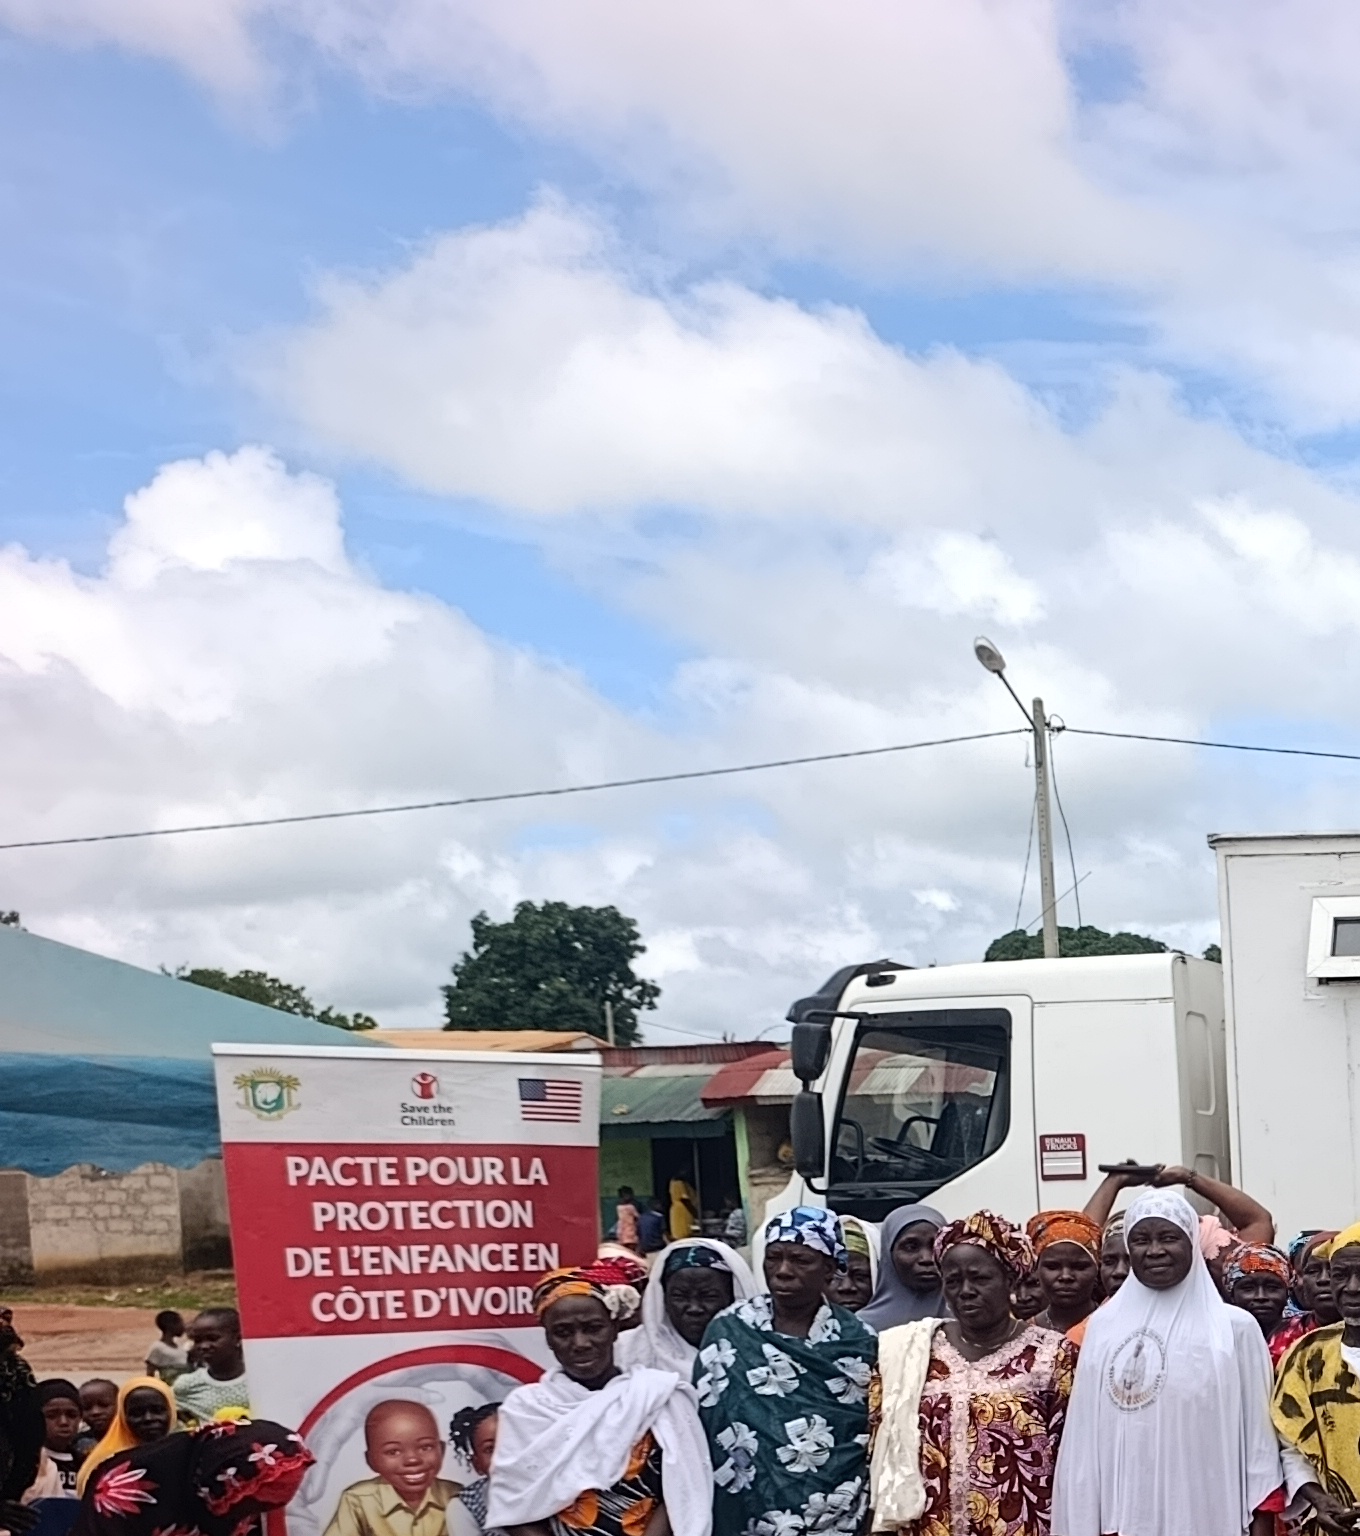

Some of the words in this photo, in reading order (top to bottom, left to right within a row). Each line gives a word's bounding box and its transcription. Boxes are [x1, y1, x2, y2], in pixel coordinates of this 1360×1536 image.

[400, 1102, 430, 1114] Save
[432, 1104, 453, 1114] the
[400, 1115, 456, 1127] Children
[286, 1156, 399, 1187] PACTE
[406, 1155, 507, 1185] POUR
[512, 1155, 549, 1186] LA
[313, 1199, 534, 1233] PROTECTION
[285, 1246, 332, 1278] DE
[339, 1243, 520, 1275] L'ENFANCE
[523, 1242, 560, 1271] EN
[311, 1285, 407, 1322] CÔTE
[413, 1285, 535, 1320] D'IVOIR
